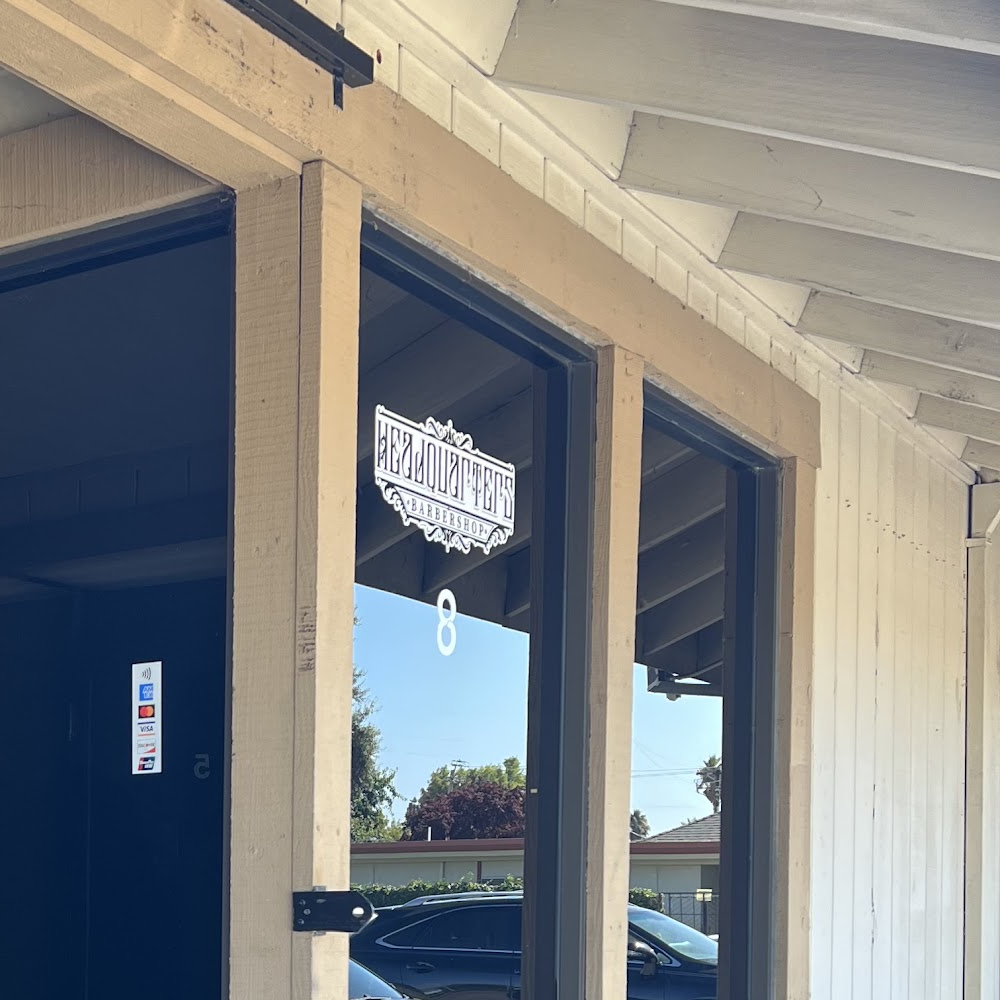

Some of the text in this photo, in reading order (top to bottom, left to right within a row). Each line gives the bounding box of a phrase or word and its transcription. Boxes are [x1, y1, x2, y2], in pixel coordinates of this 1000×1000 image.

[377, 420, 513, 520] HEADQUARTERS
[411, 497, 485, 537] BARBERSHOP
[436, 588, 457, 656] 8
[140, 725, 153, 733] VISA
